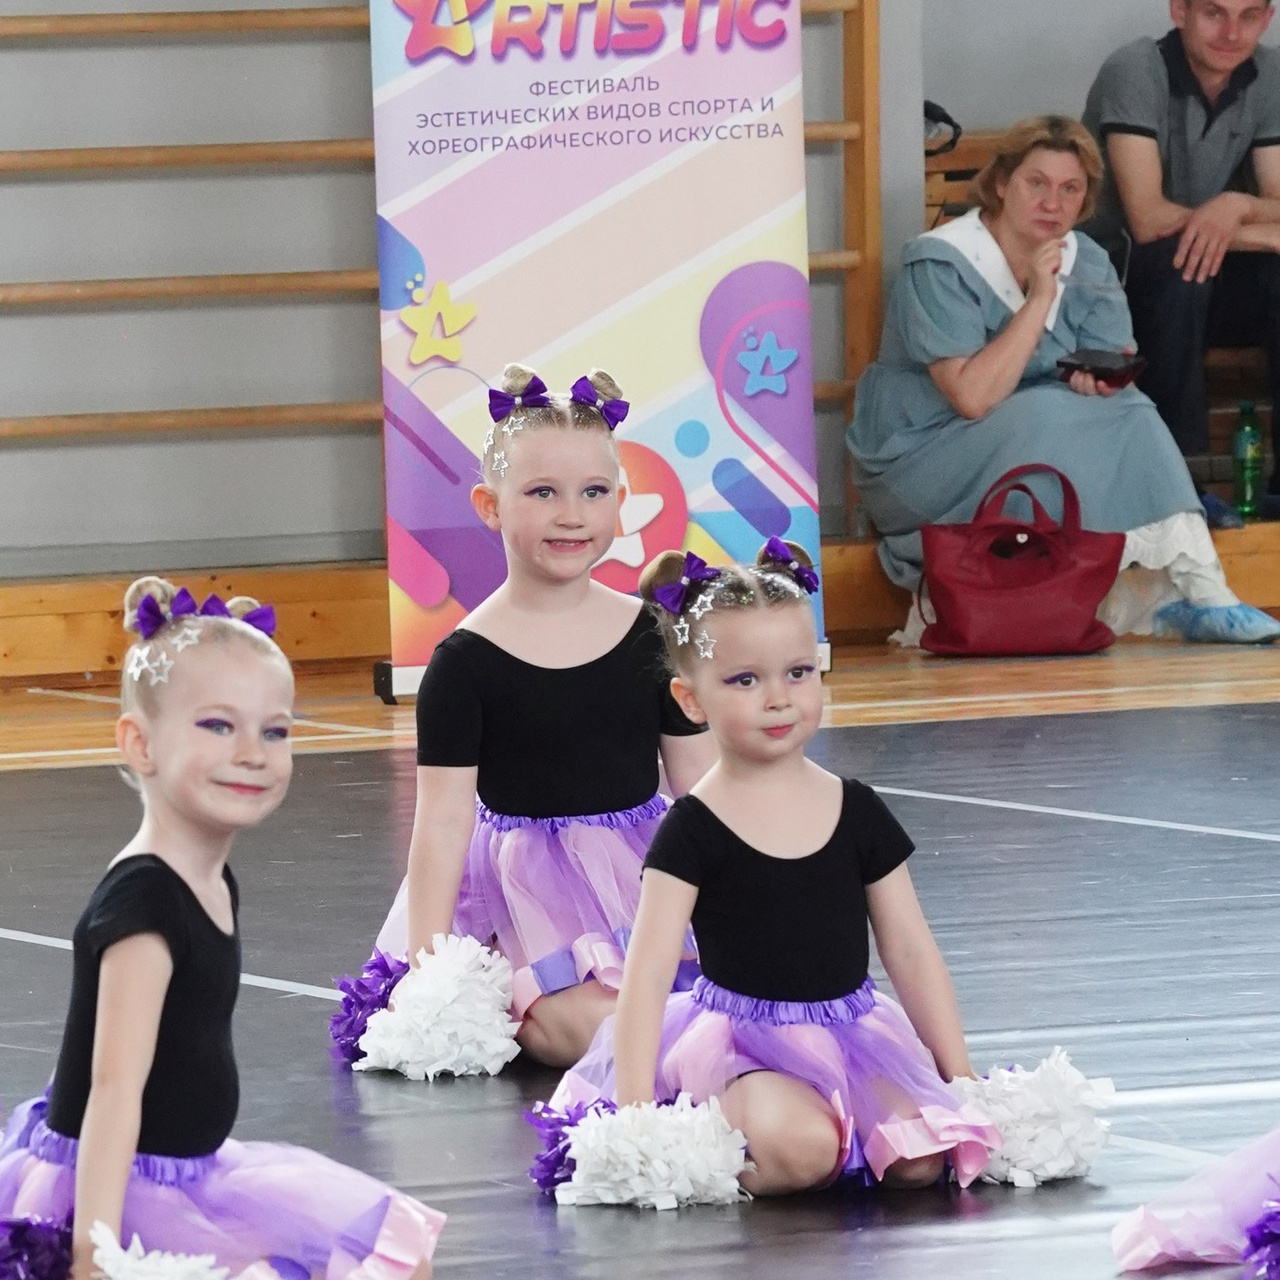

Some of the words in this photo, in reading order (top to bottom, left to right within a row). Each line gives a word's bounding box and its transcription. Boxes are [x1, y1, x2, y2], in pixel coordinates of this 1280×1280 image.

[528, 76, 660, 97] ФЕСТИВАЛЬ
[415, 105, 580, 129] ЭСТЕТИЧЕСКИХ
[586, 102, 662, 122] ВИДОВ
[667, 97, 754, 118] СПОРТА
[760, 96, 775, 113] И
[407, 129, 653, 157] ХОРЕОГРАФИЧЕСКОГО
[658, 122, 784, 144] ИСКУССТВА
